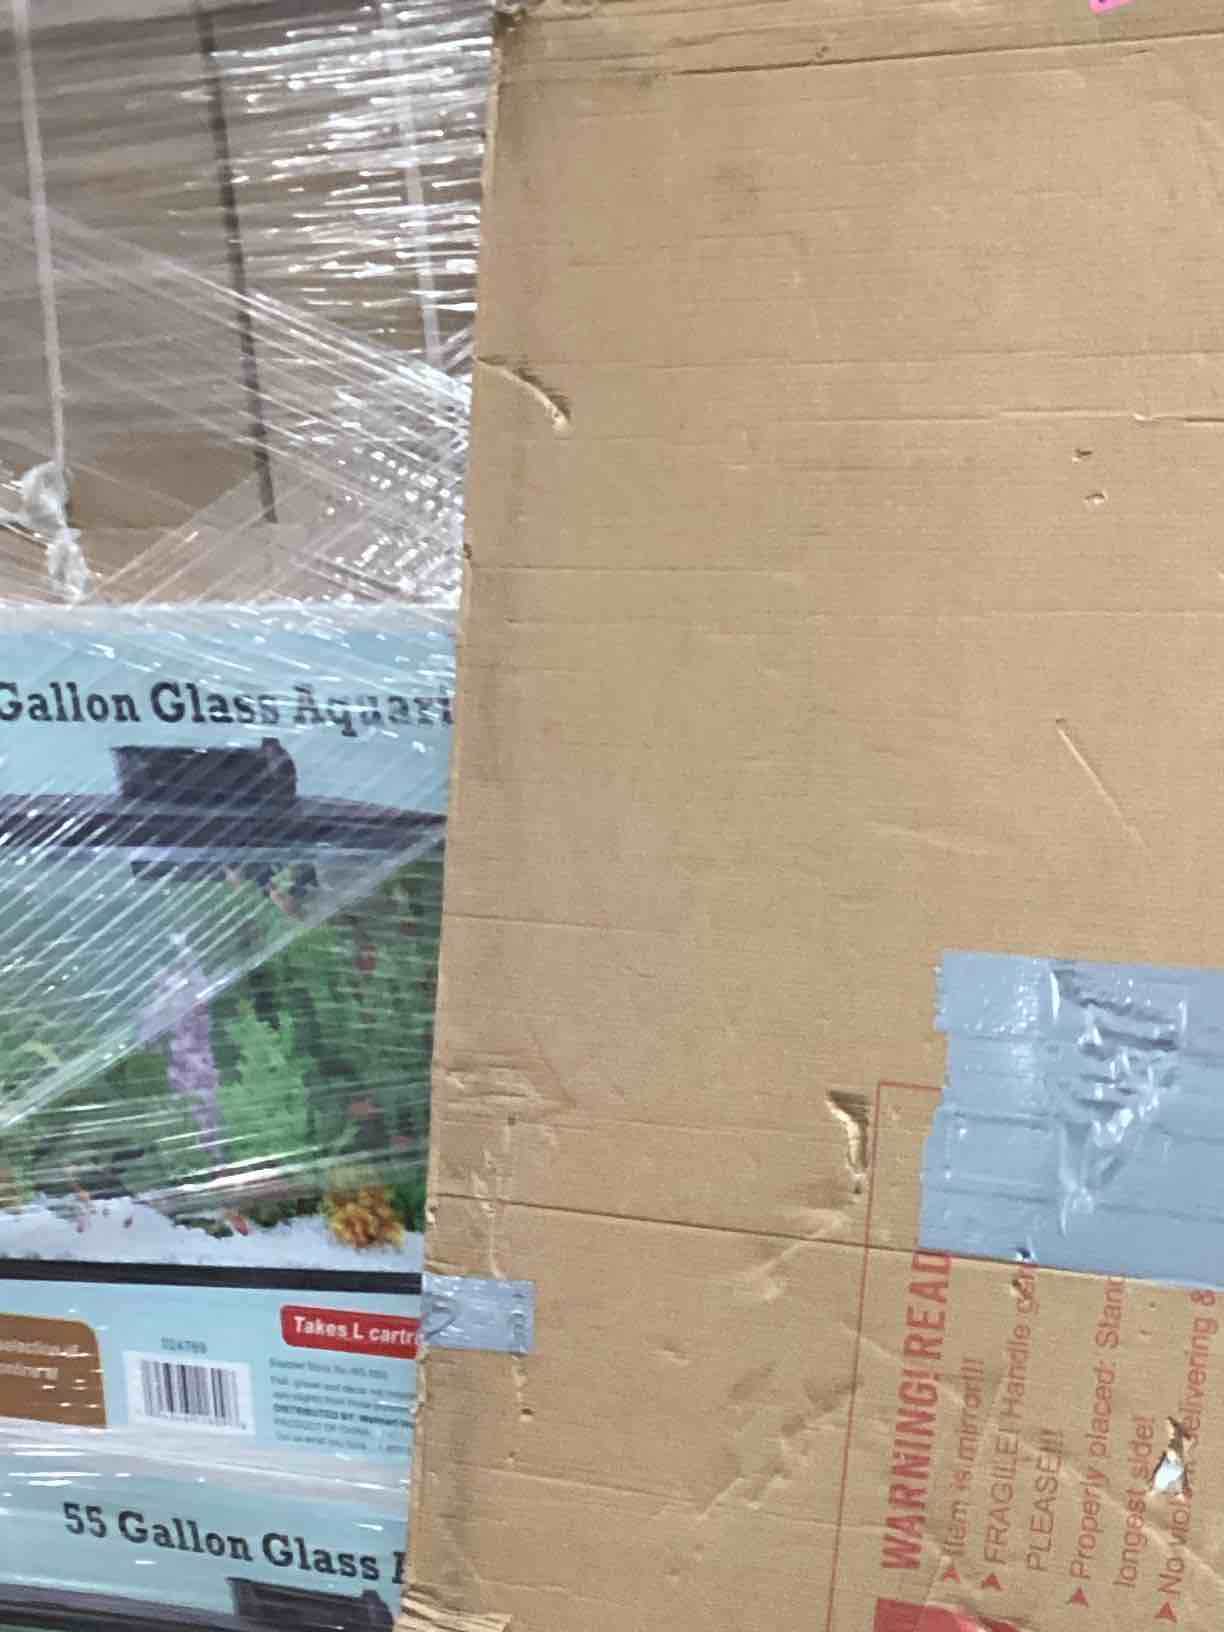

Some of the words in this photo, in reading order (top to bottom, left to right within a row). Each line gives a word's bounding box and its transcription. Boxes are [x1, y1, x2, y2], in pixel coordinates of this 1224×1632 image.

[0, 682, 141, 723] Gallon
[150, 682, 280, 724] Glass
[294, 1315, 348, 1338] Takes
[352, 1322, 364, 1340] L
[881, 1368, 942, 1569] WARNING!
[952, 1470, 973, 1491] is
[983, 1427, 1021, 1566] FRAGILE!
[1002, 1323, 1032, 1433] Handle
[1128, 1415, 1155, 1478] side!
[1025, 1427, 1065, 1572] PLEASE!!!
[1069, 1467, 1110, 1580] Properly
[1113, 1487, 1148, 1588] longest
[63, 1501, 108, 1539] 55
[118, 1510, 253, 1563] Gallon
[262, 1533, 381, 1581] Glass
[1159, 1556, 1186, 1597] No
